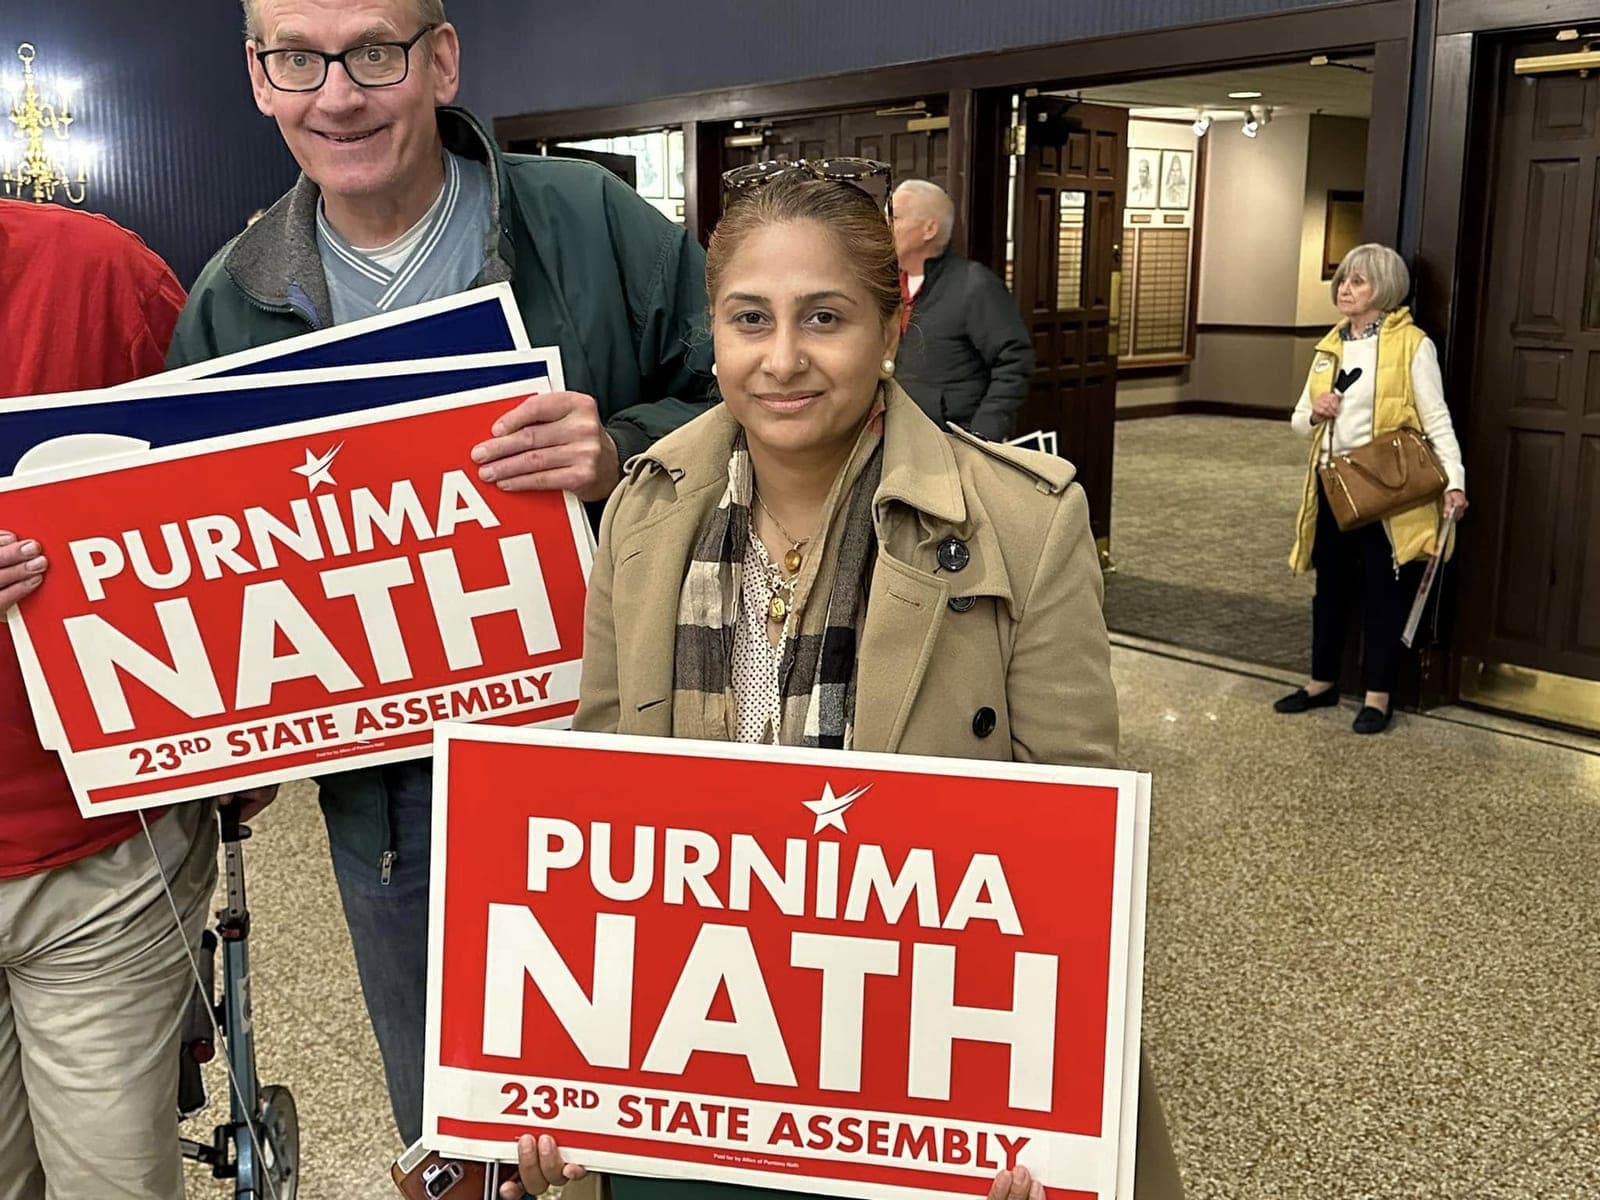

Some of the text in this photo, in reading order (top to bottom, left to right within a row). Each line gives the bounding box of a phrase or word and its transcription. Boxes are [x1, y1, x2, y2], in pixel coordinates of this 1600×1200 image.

[69, 469, 501, 602] PURNIMA
[63, 532, 561, 734] NATH
[128, 671, 552, 775] 23RD STATE ASSEMBLY
[527, 816, 1024, 936] PURNIMA
[482, 902, 1059, 1113] NATH
[500, 1082, 1031, 1173] 23RD STATE ASSEMBLY
